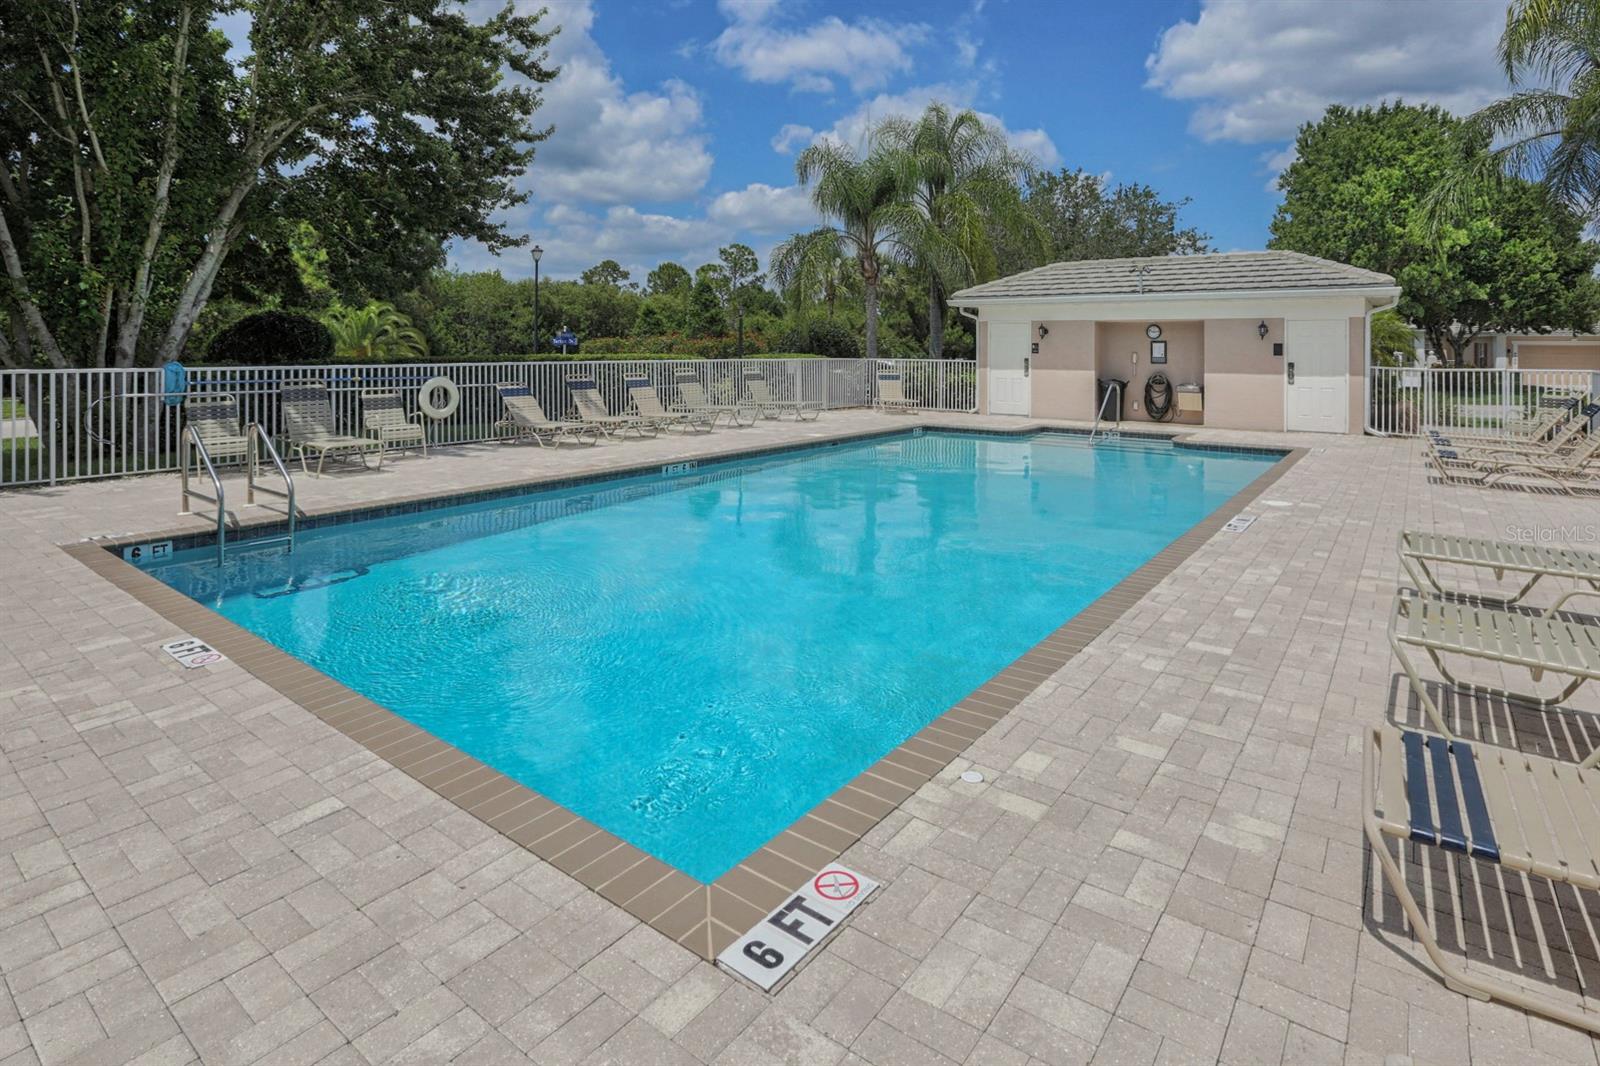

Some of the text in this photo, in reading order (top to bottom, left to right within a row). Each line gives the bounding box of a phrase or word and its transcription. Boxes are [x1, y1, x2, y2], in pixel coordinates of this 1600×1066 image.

[168, 641, 212, 659] 6 FT
[742, 895, 835, 969] 6 FT
